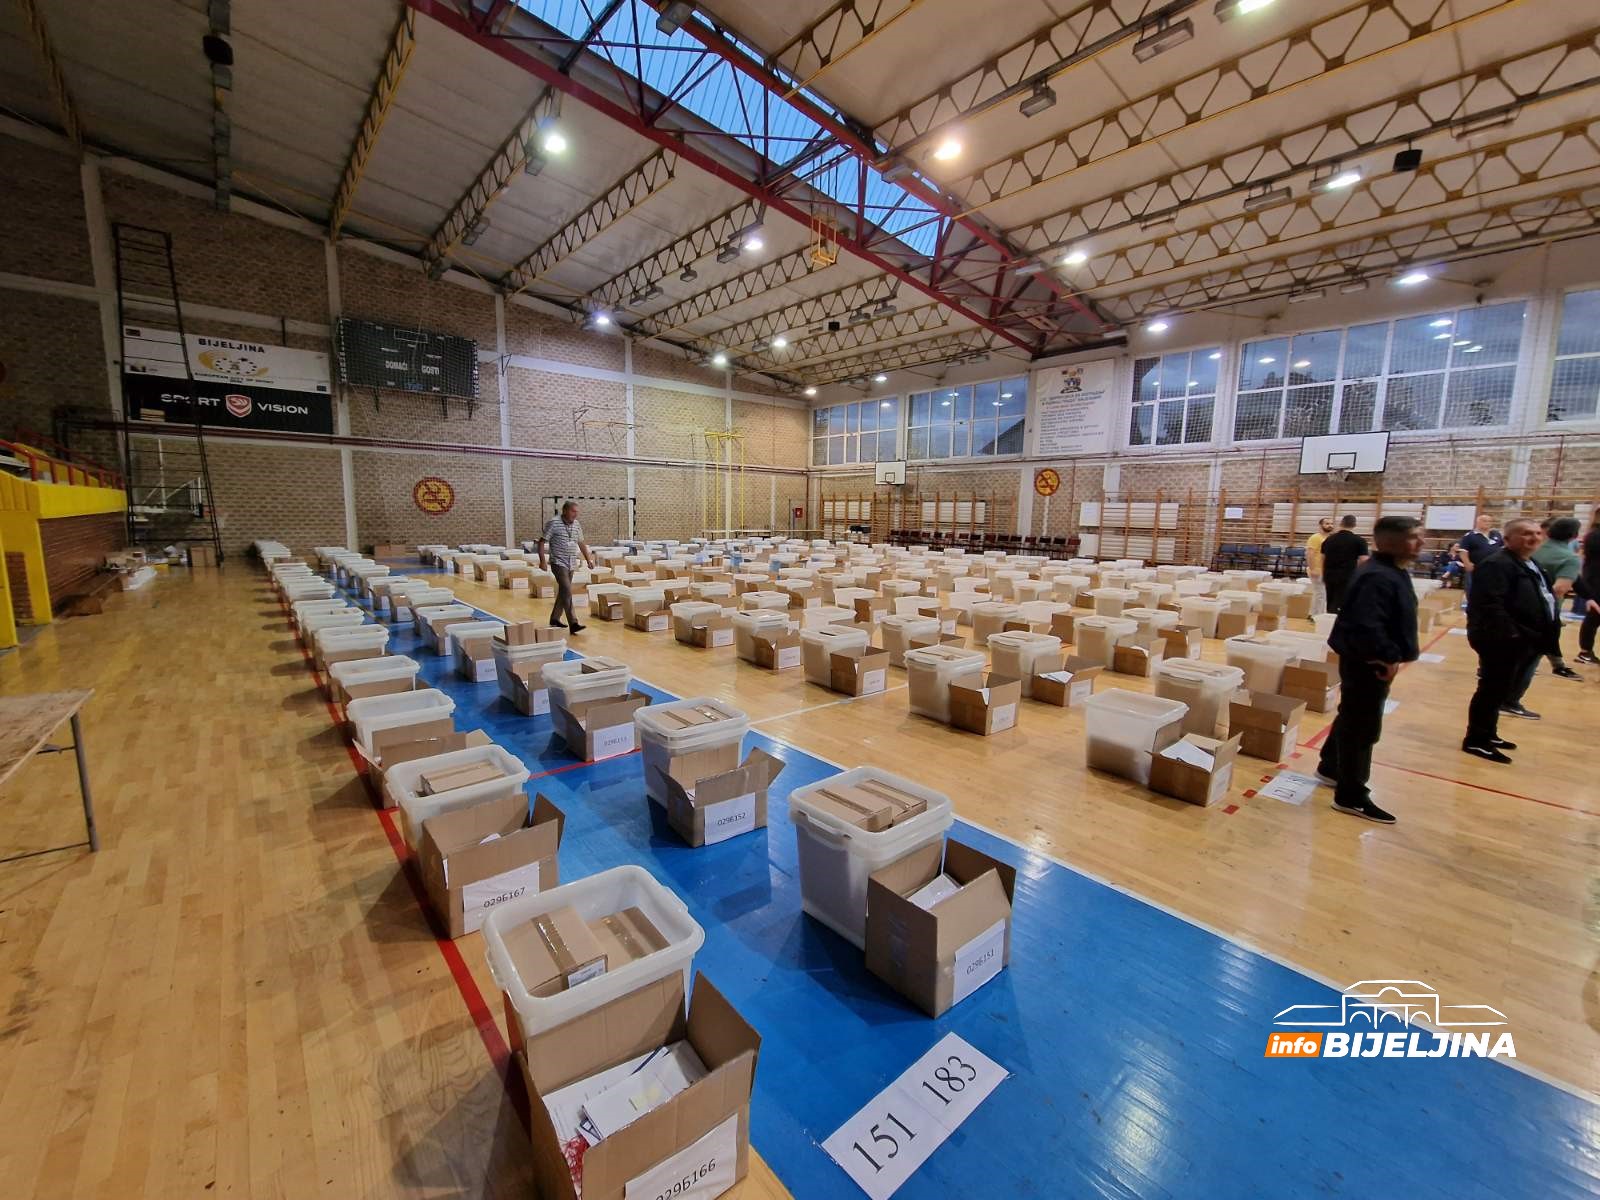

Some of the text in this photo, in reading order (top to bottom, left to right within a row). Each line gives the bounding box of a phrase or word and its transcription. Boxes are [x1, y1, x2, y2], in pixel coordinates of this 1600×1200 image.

[198, 338, 265, 353] BIJELJINA
[257, 402, 309, 415] VISION
[852, 1055, 977, 1174] 151 183
